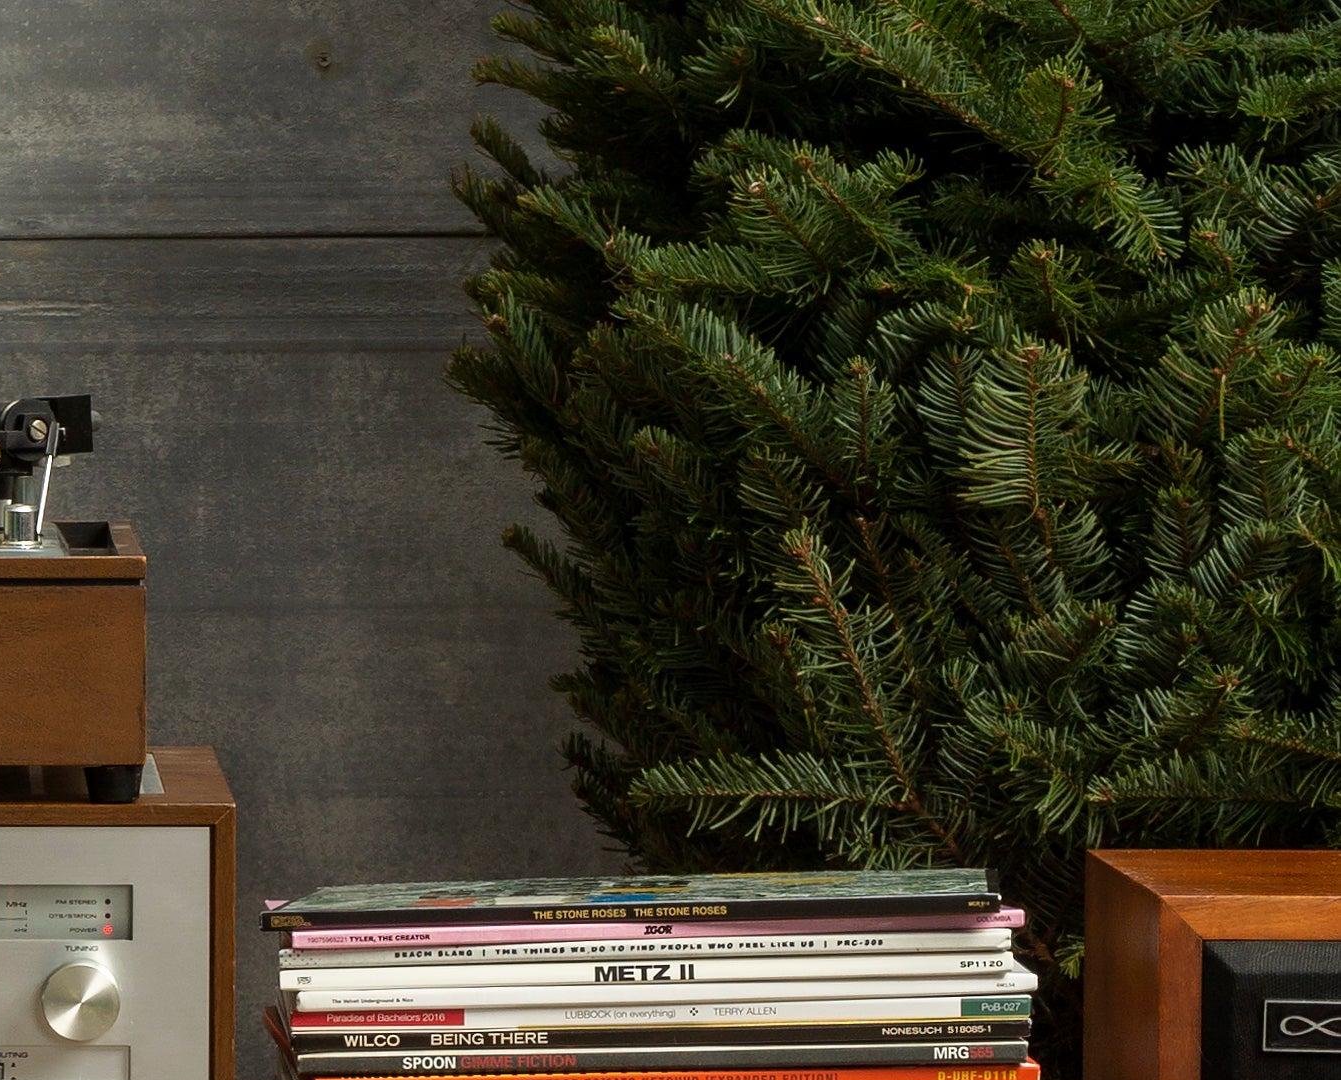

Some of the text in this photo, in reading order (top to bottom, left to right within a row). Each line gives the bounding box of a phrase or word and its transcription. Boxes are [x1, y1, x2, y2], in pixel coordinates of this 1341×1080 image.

[5, 900, 27, 908] MHz
[533, 905, 727, 920] THE STONE ROSES THE STONE ROSES
[644, 925, 673, 935] IGOR
[524, 947, 565, 955] THINGS
[708, 942, 733, 950] WHO
[801, 940, 815, 948] US
[594, 960, 1003, 982] METZ II SP1120
[326, 1001, 1021, 1022] Paradise of Bachelors 2016 LUBBOCK (on everything) TERRY ALLEN PoB-027
[344, 1034, 400, 1047] WILCO
[430, 1033, 485, 1046] BEING
[488, 1032, 549, 1045] THERE
[882, 1026, 943, 1036] NONESUCH
[402, 1056, 457, 1070] SPOON
[461, 1056, 514, 1069] GIMME
[517, 1055, 577, 1068] FICTION
